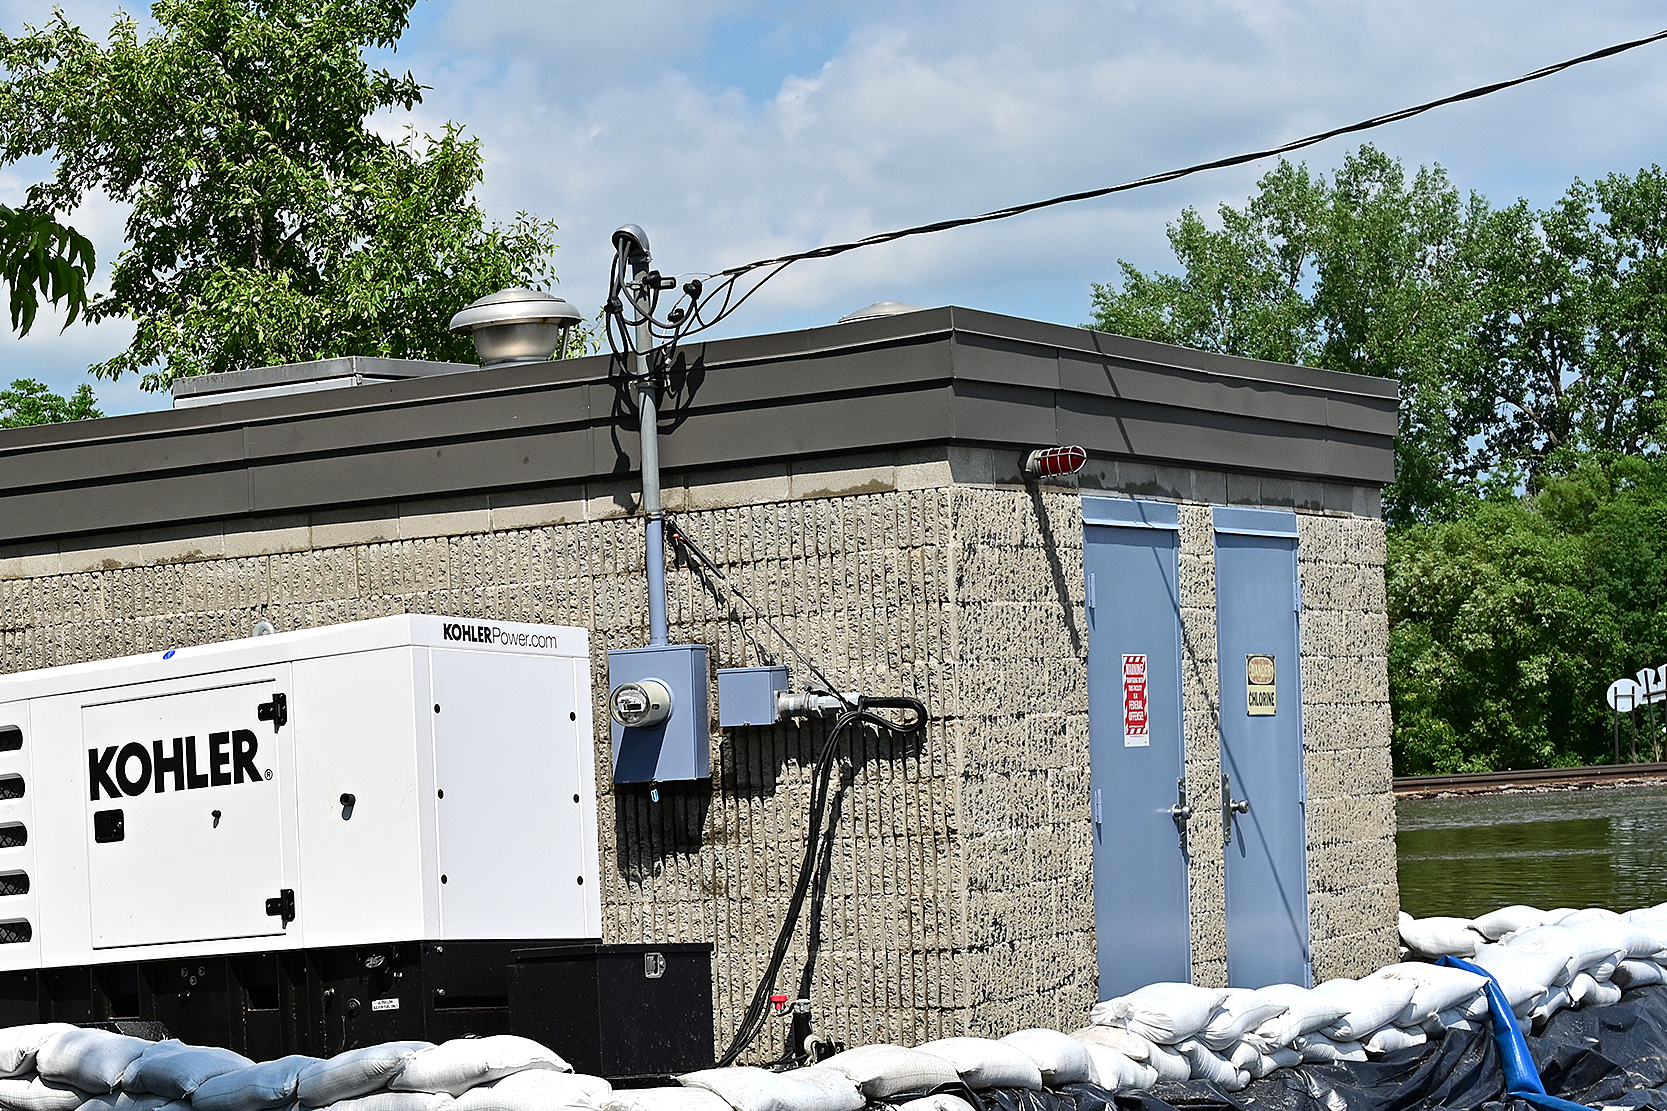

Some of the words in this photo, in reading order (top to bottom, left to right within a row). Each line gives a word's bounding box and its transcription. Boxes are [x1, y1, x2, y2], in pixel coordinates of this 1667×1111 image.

[443, 623, 557, 648] KOHLERPower.com
[1129, 700, 1143, 709] FEDERAL
[1248, 691, 1275, 706] CHLORINE
[88, 729, 264, 801] KOHLER
